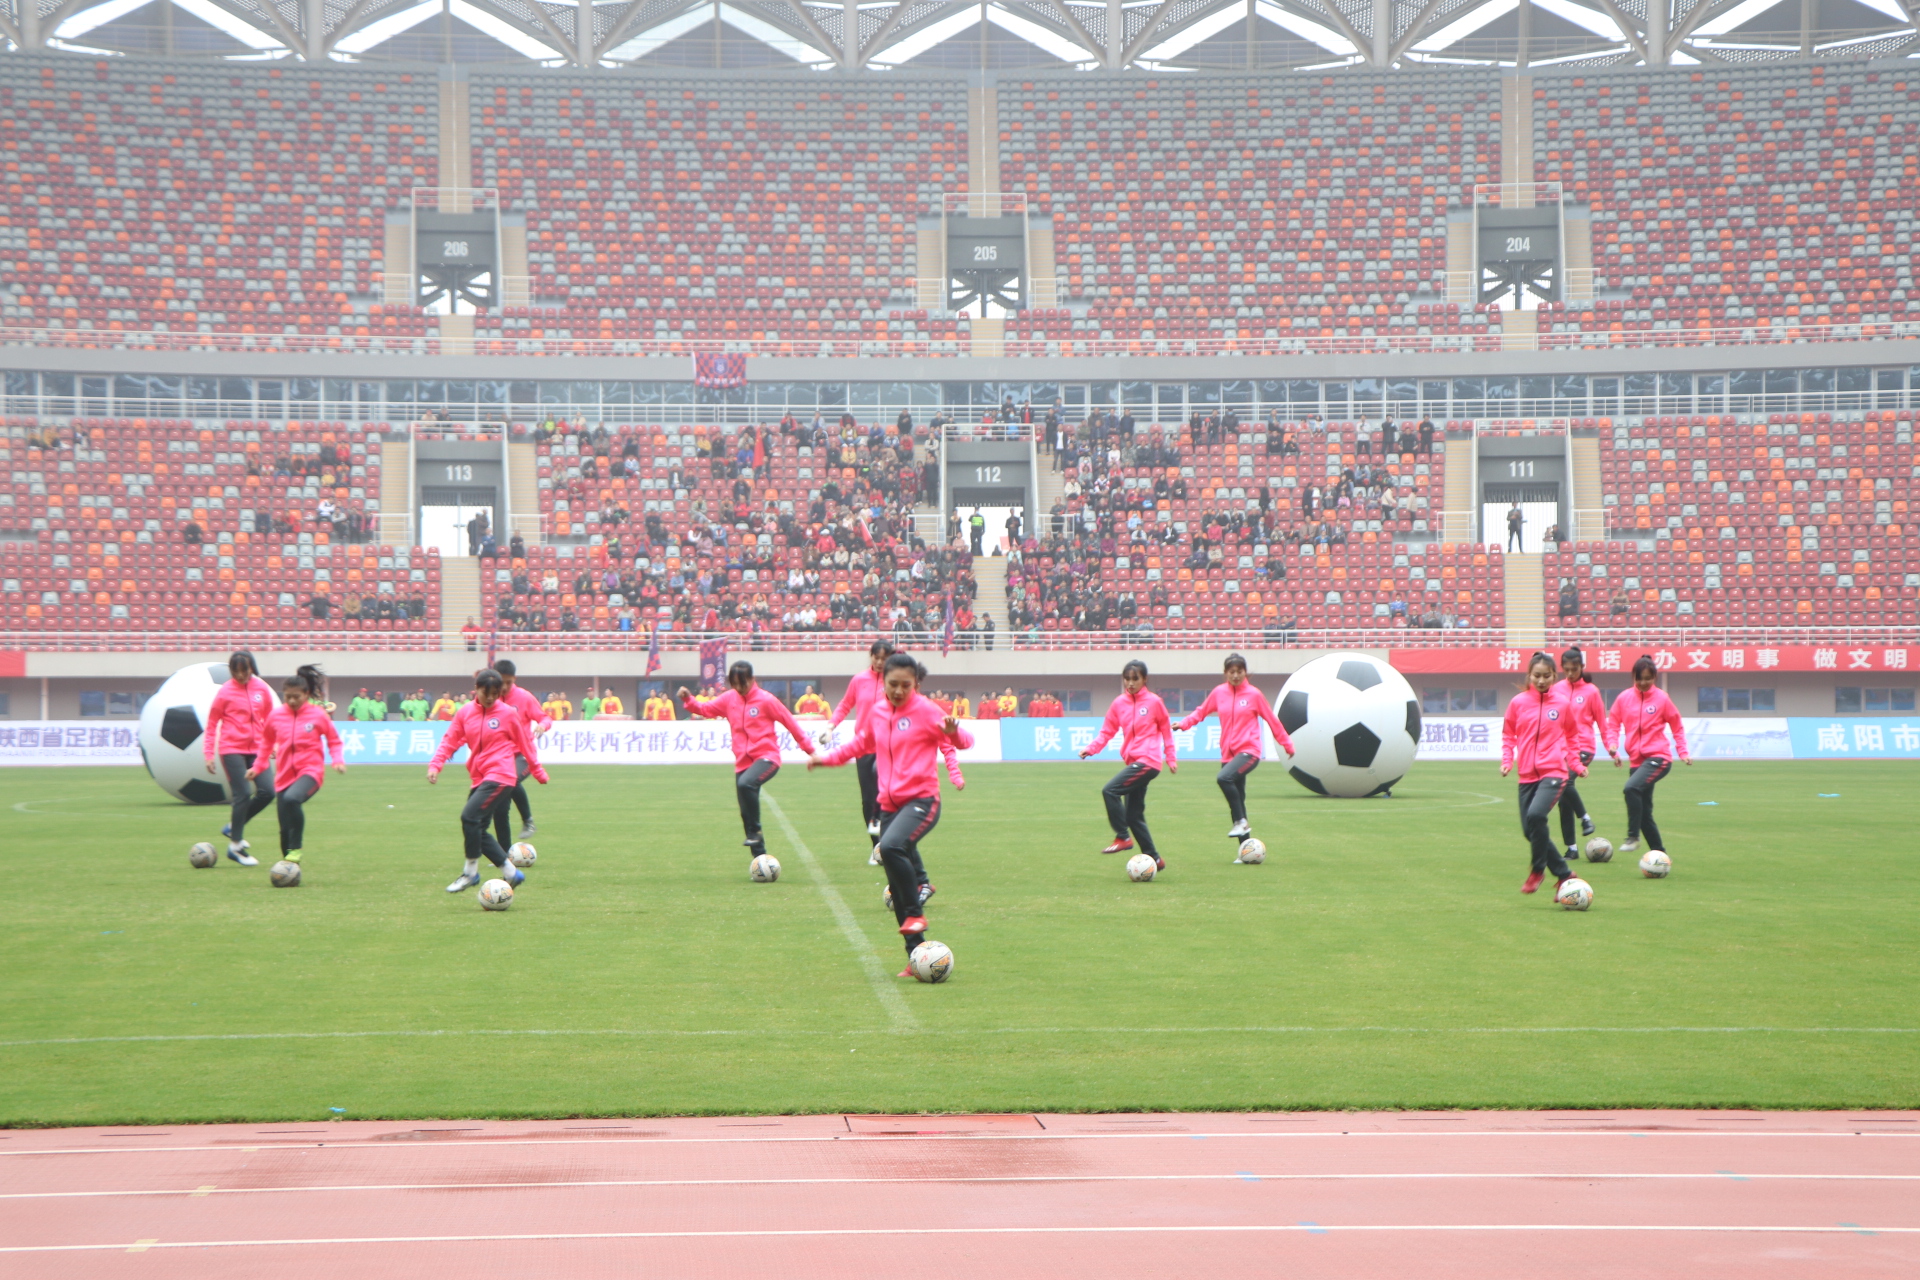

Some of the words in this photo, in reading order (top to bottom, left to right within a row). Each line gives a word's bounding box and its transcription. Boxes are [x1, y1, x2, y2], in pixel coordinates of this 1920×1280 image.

[443, 241, 469, 256] 206
[973, 245, 997, 260] 205
[1506, 237, 1531, 252] 204
[445, 464, 473, 481] 113
[975, 466, 1001, 482] 112
[1509, 460, 1534, 477] 111
[1653, 649, 1780, 669] 办文明事
[0, 727, 139, 747] 陕西省足球协
[1420, 723, 1489, 743] 球协会
[1817, 724, 1920, 752] 咸阳市
[1428, 744, 1489, 752] ASSOCIATION
